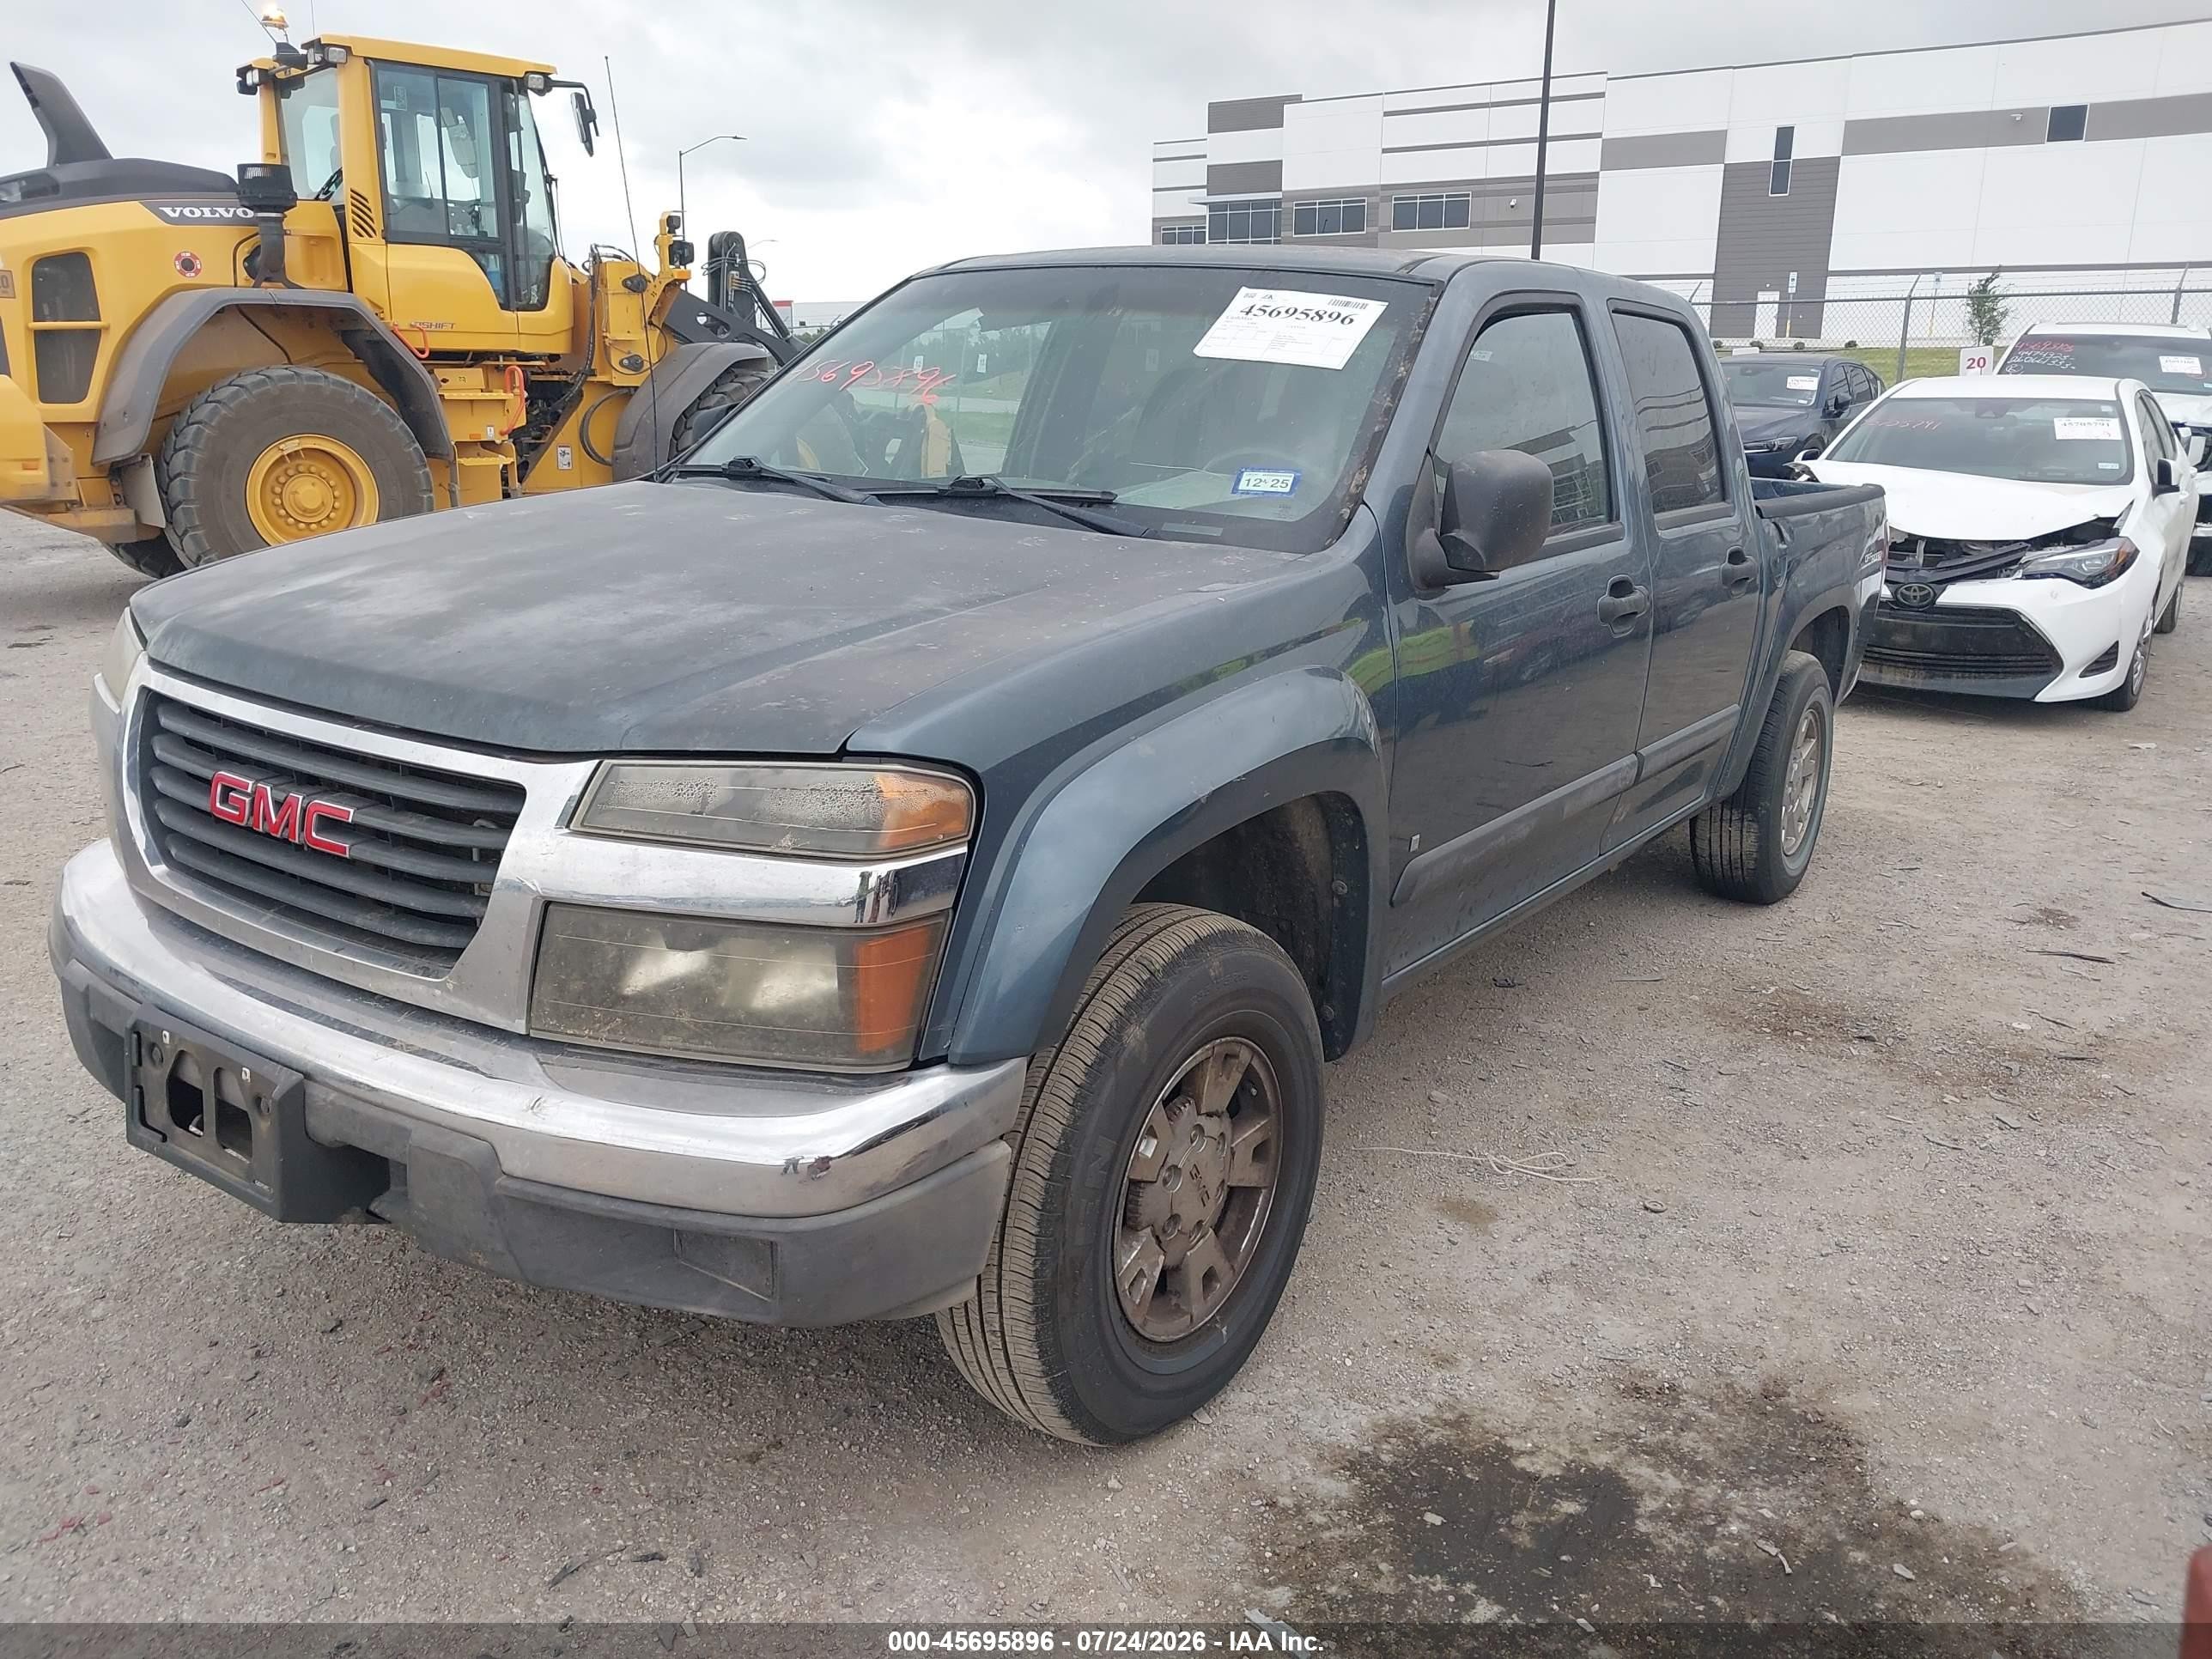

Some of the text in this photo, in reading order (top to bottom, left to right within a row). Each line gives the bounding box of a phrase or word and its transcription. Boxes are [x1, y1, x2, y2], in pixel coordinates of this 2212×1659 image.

[159, 207, 254, 218] VOLVO
[1240, 303, 1359, 325] 45695896
[1966, 356, 1987, 369] 20
[1244, 477, 1290, 489] 12 25
[210, 771, 357, 859] GMC
